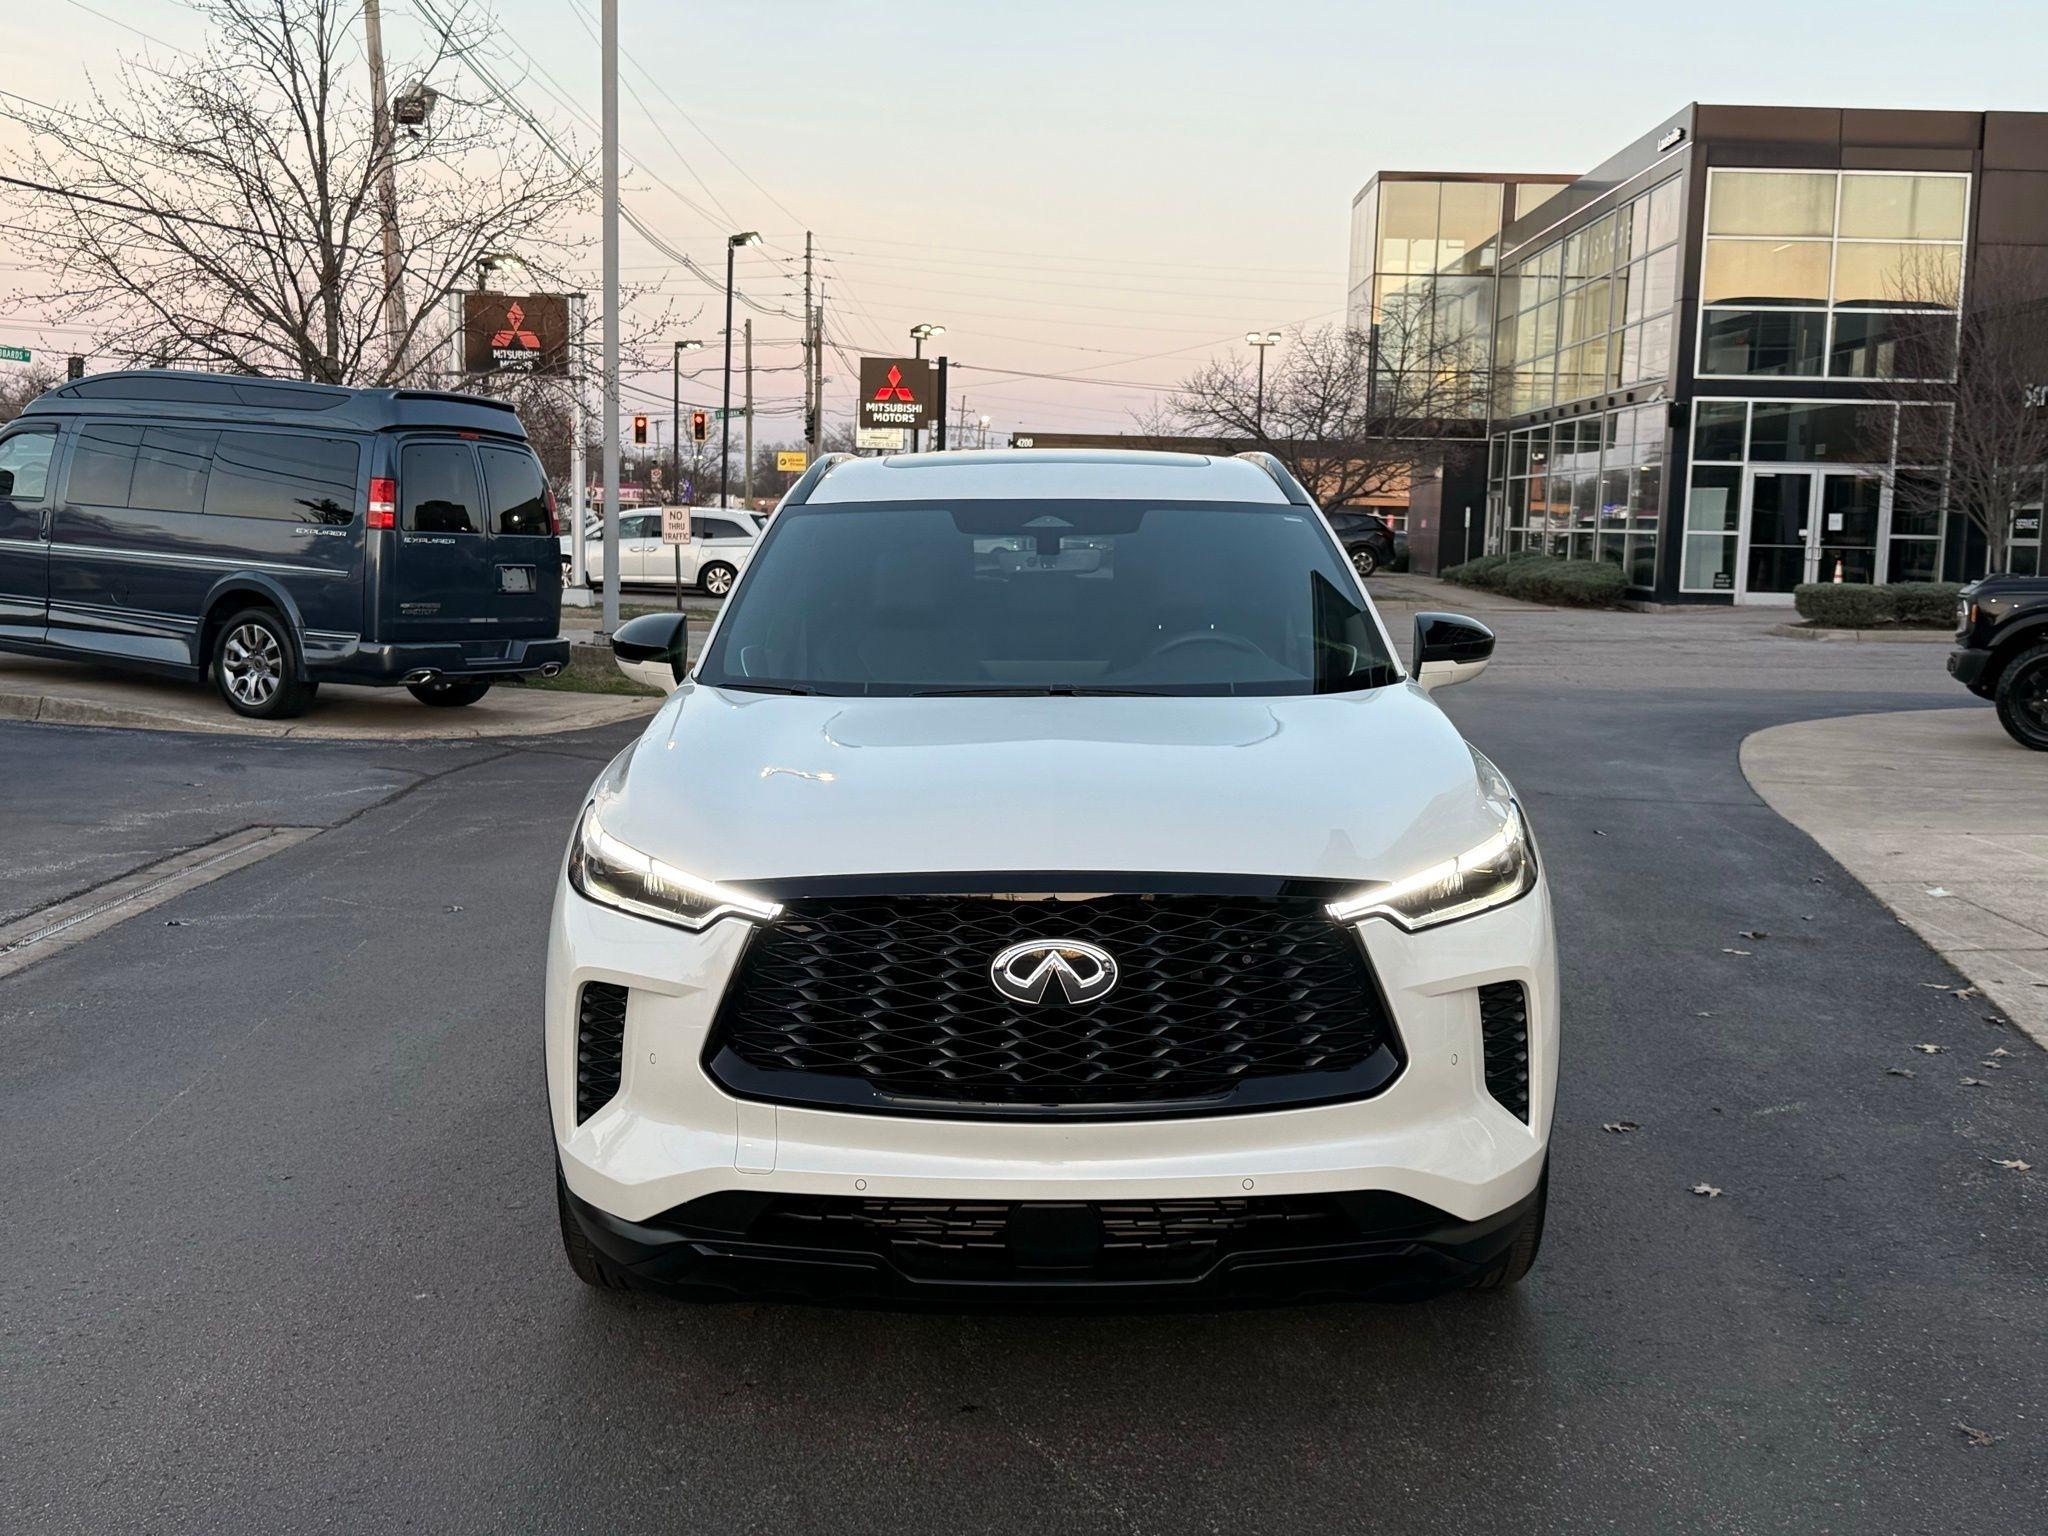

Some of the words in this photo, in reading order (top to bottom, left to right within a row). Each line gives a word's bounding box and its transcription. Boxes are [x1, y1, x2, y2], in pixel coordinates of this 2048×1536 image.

[865, 402, 922, 413] MITSUBISHI
[873, 412, 915, 422] MOTORS
[1016, 438, 1033, 447] 4200
[670, 511, 682, 520] NO
[669, 523, 685, 531] THRU
[2015, 518, 2038, 529] SERVICE
[665, 532, 689, 541] TRAFFIC
